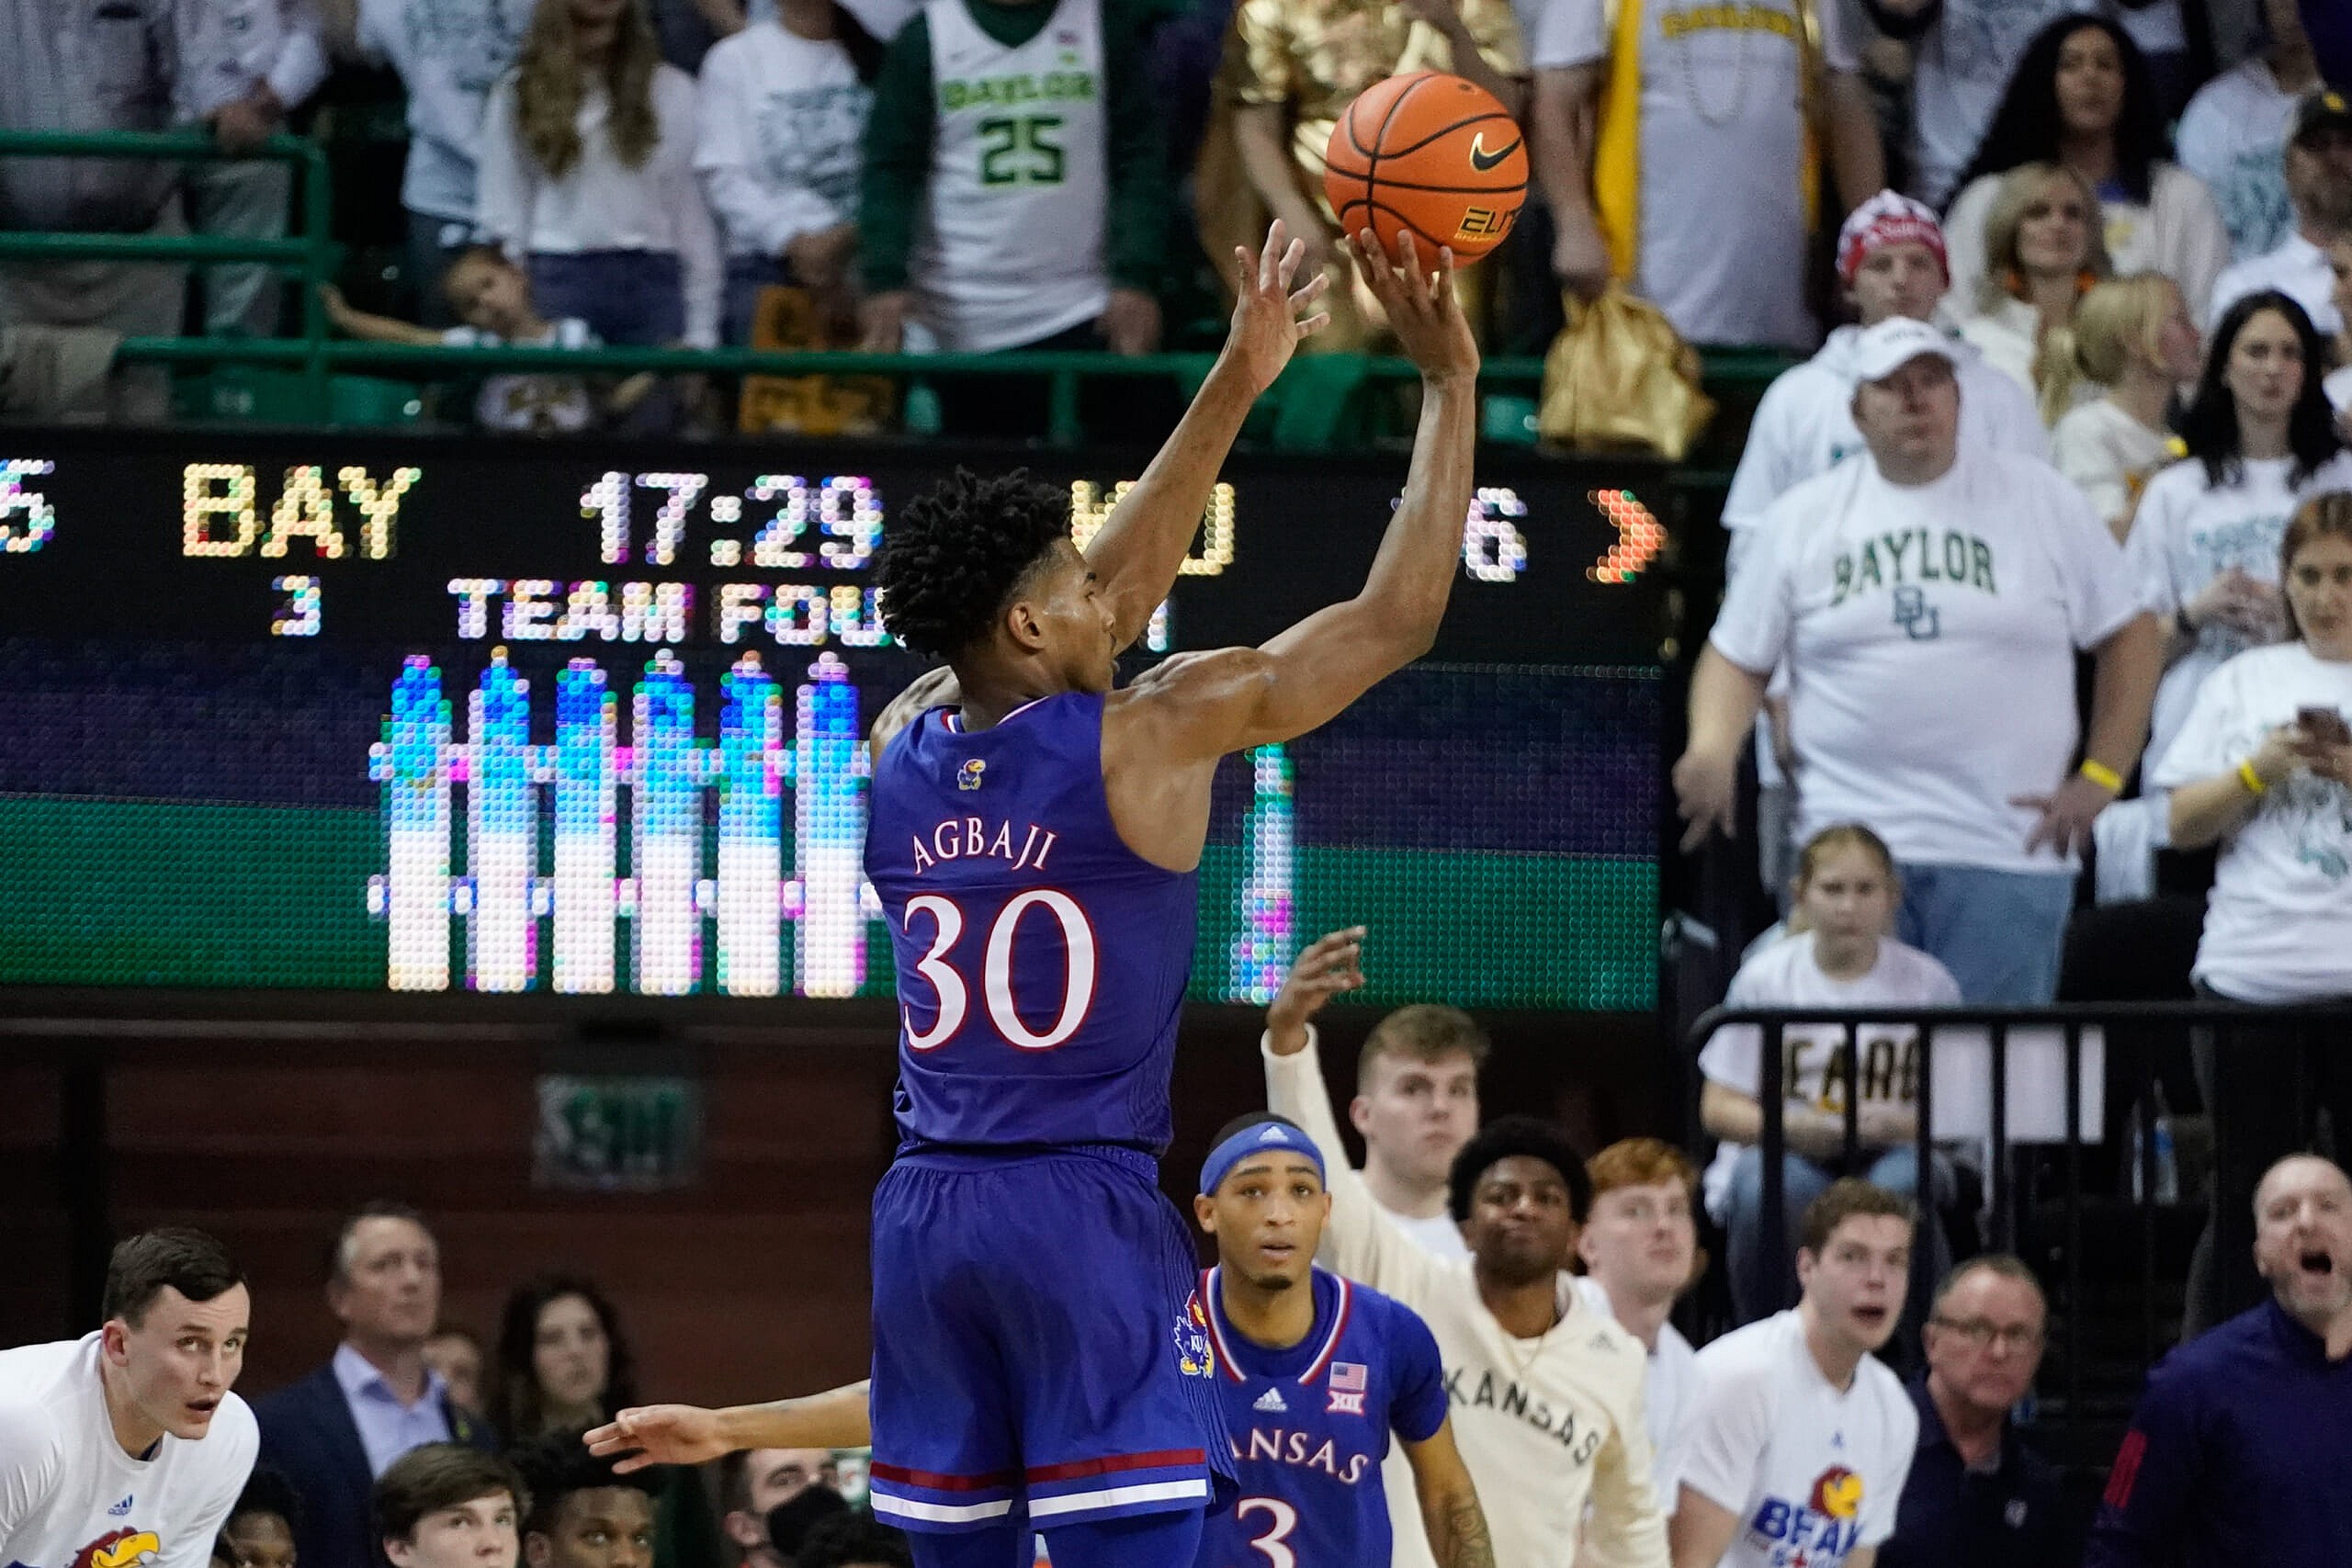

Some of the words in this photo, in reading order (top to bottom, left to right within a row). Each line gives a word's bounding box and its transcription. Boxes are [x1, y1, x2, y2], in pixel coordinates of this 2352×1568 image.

[978, 116, 1063, 183] 25
[184, 463, 423, 559] BAY
[580, 471, 884, 569] 17:29
[1828, 526, 1996, 607] BAYLOR
[272, 575, 322, 636] 3
[447, 578, 695, 642] TEAM
[722, 583, 905, 646] FOU
[1893, 585, 1939, 638] BU
[912, 816, 1057, 874] AGBAJI
[903, 887, 1099, 1051] 30
[1785, 1037, 1918, 1100] EAR
[1442, 1367, 1600, 1467] KANSAS
[1229, 1427, 1370, 1485] NSAS
[1237, 1495, 1300, 1568] 3
